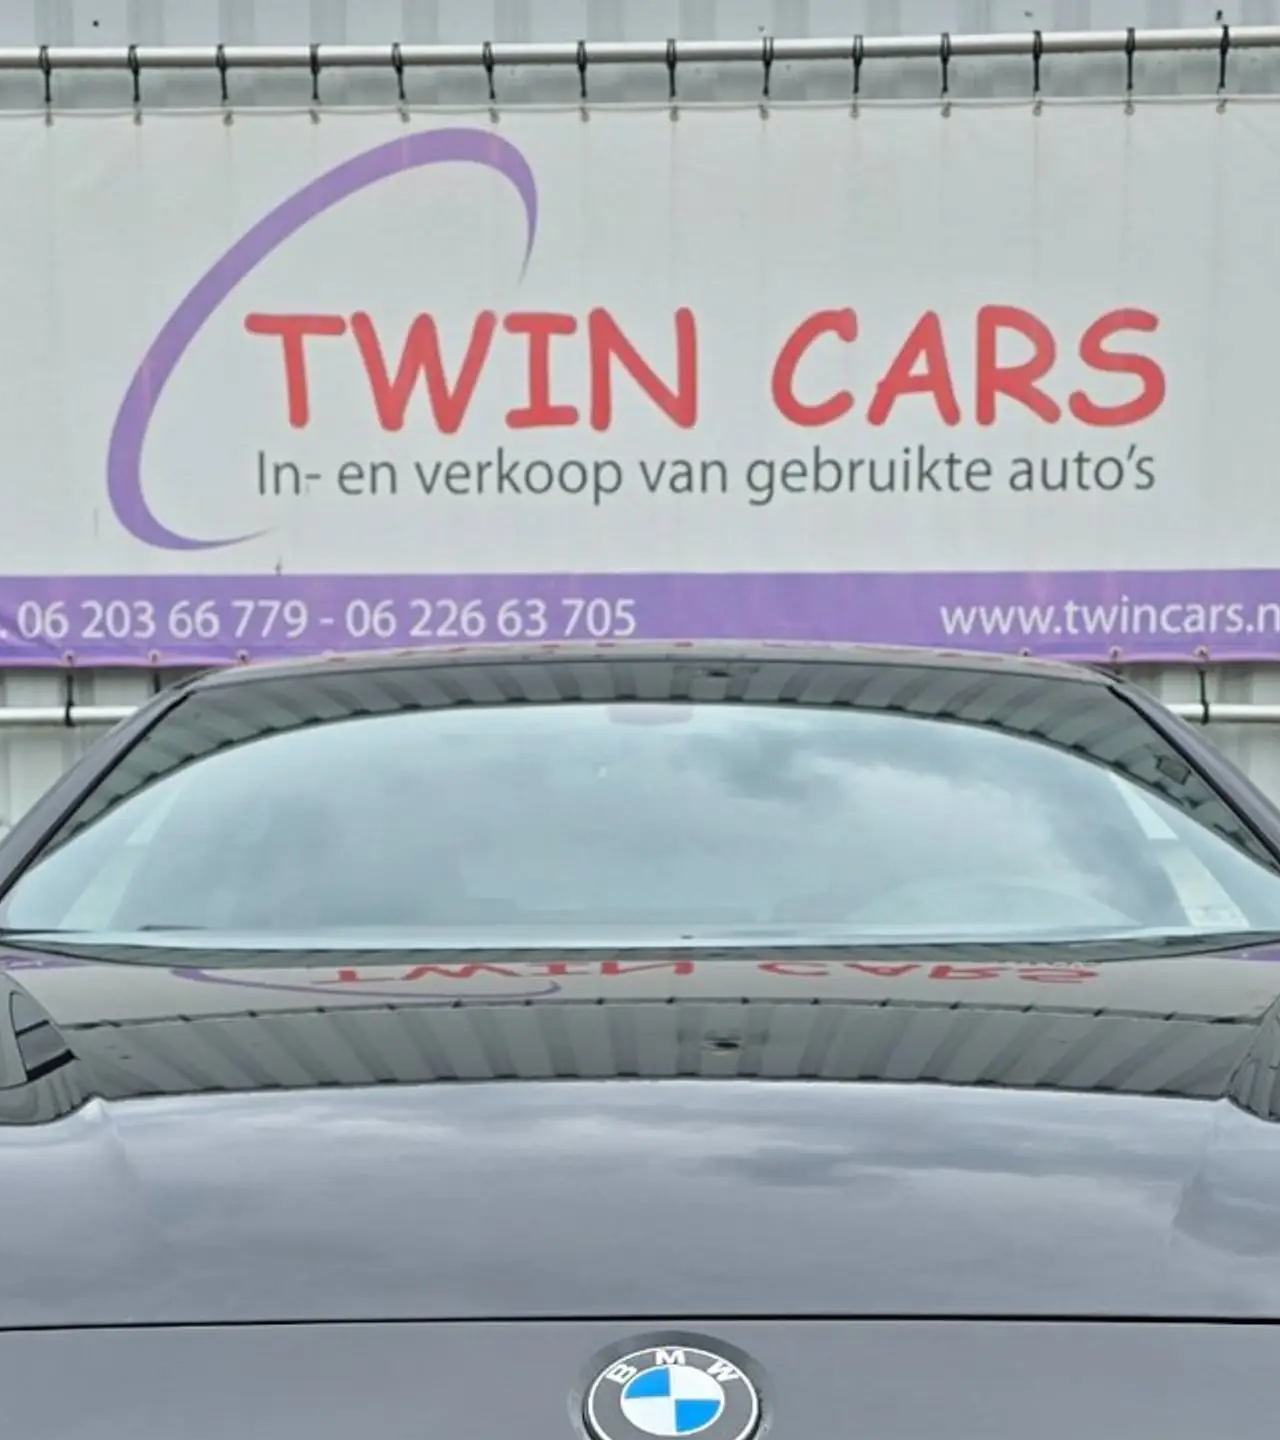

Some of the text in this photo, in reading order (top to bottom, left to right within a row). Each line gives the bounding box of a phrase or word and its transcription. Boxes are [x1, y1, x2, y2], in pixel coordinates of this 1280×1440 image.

[244, 304, 1166, 434] TWIN CARS
[257, 443, 1156, 507] In- en verkoop van gebruikte auto's
[17, 601, 69, 639] 06
[81, 600, 156, 639] 203
[168, 600, 220, 638] 66
[232, 600, 308, 638] 779
[345, 599, 397, 638] 06
[409, 599, 486, 638] 226
[497, 598, 547, 637] 63
[562, 598, 637, 637] 705
[606, 1349, 740, 1385] BMW
